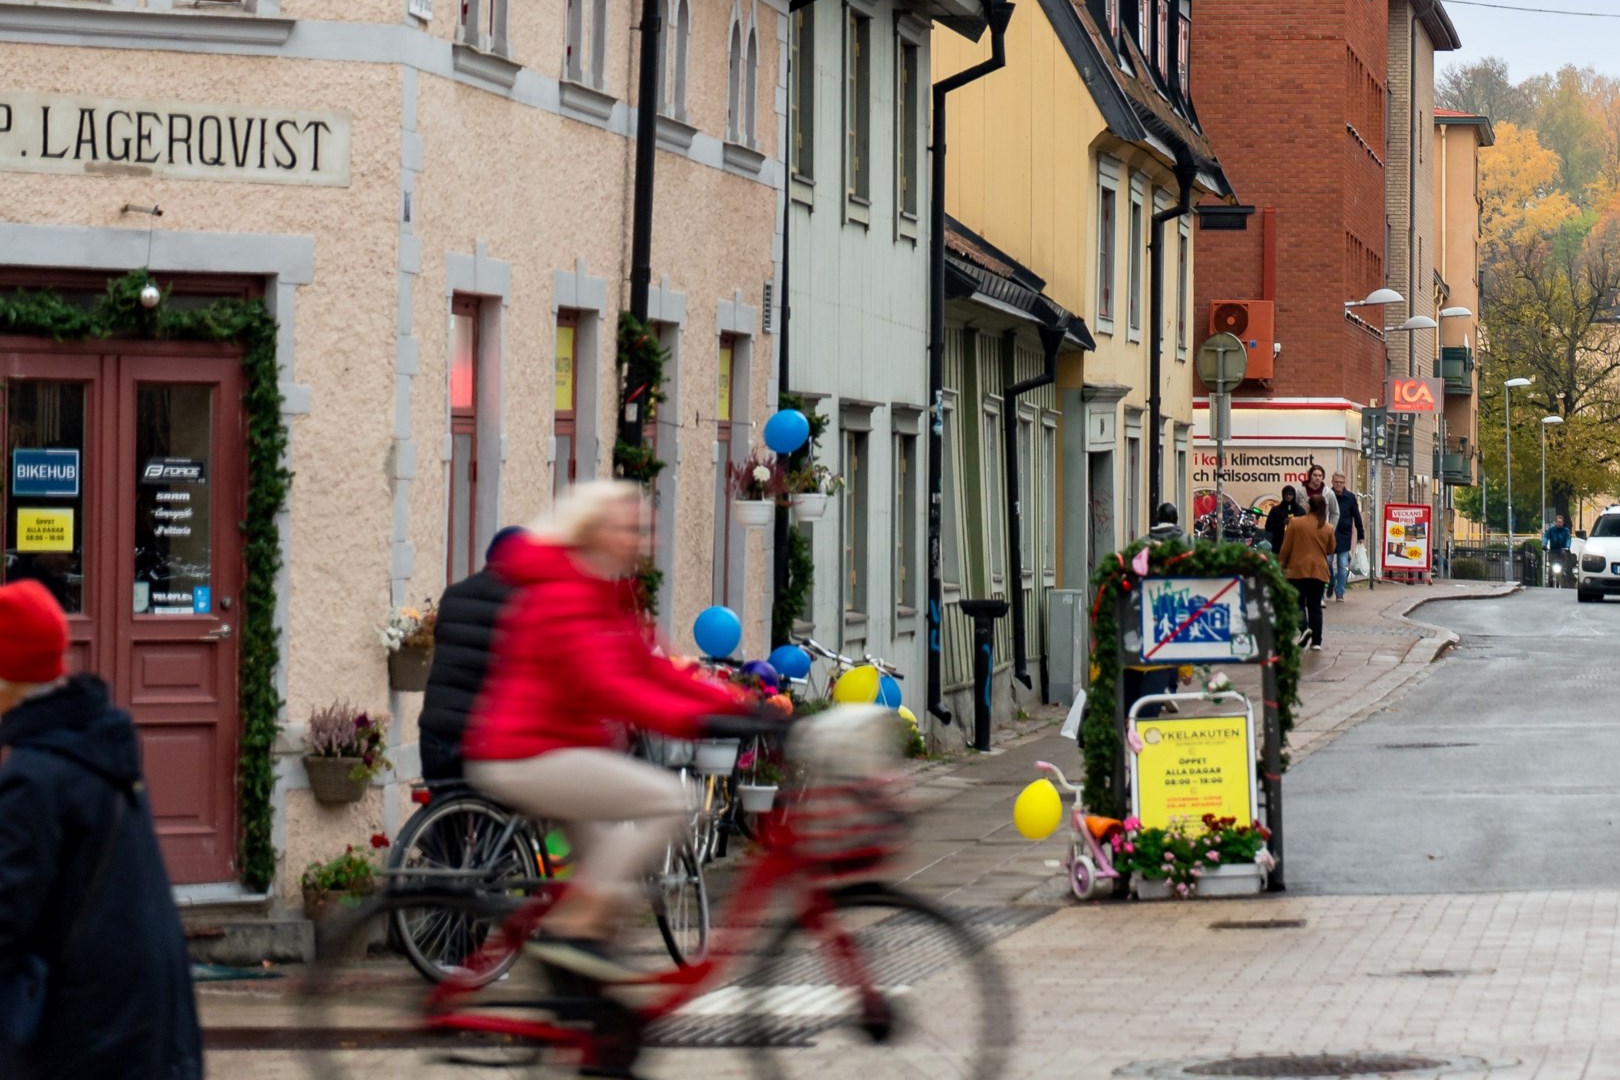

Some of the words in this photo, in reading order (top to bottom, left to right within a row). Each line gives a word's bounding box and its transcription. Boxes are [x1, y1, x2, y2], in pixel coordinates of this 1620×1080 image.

[40, 106, 331, 171] LAGERQVIST
[1394, 381, 1434, 402] ICA
[1231, 454, 1314, 466] klimatsmart
[17, 464, 76, 478] BIKEHUB
[1193, 469, 1209, 482] ch
[1213, 469, 1280, 482] hälsosam
[1178, 757, 1206, 765] ÖPPET
[1165, 768, 1187, 776] ALLA
[1189, 767, 1221, 775] DAGAR
